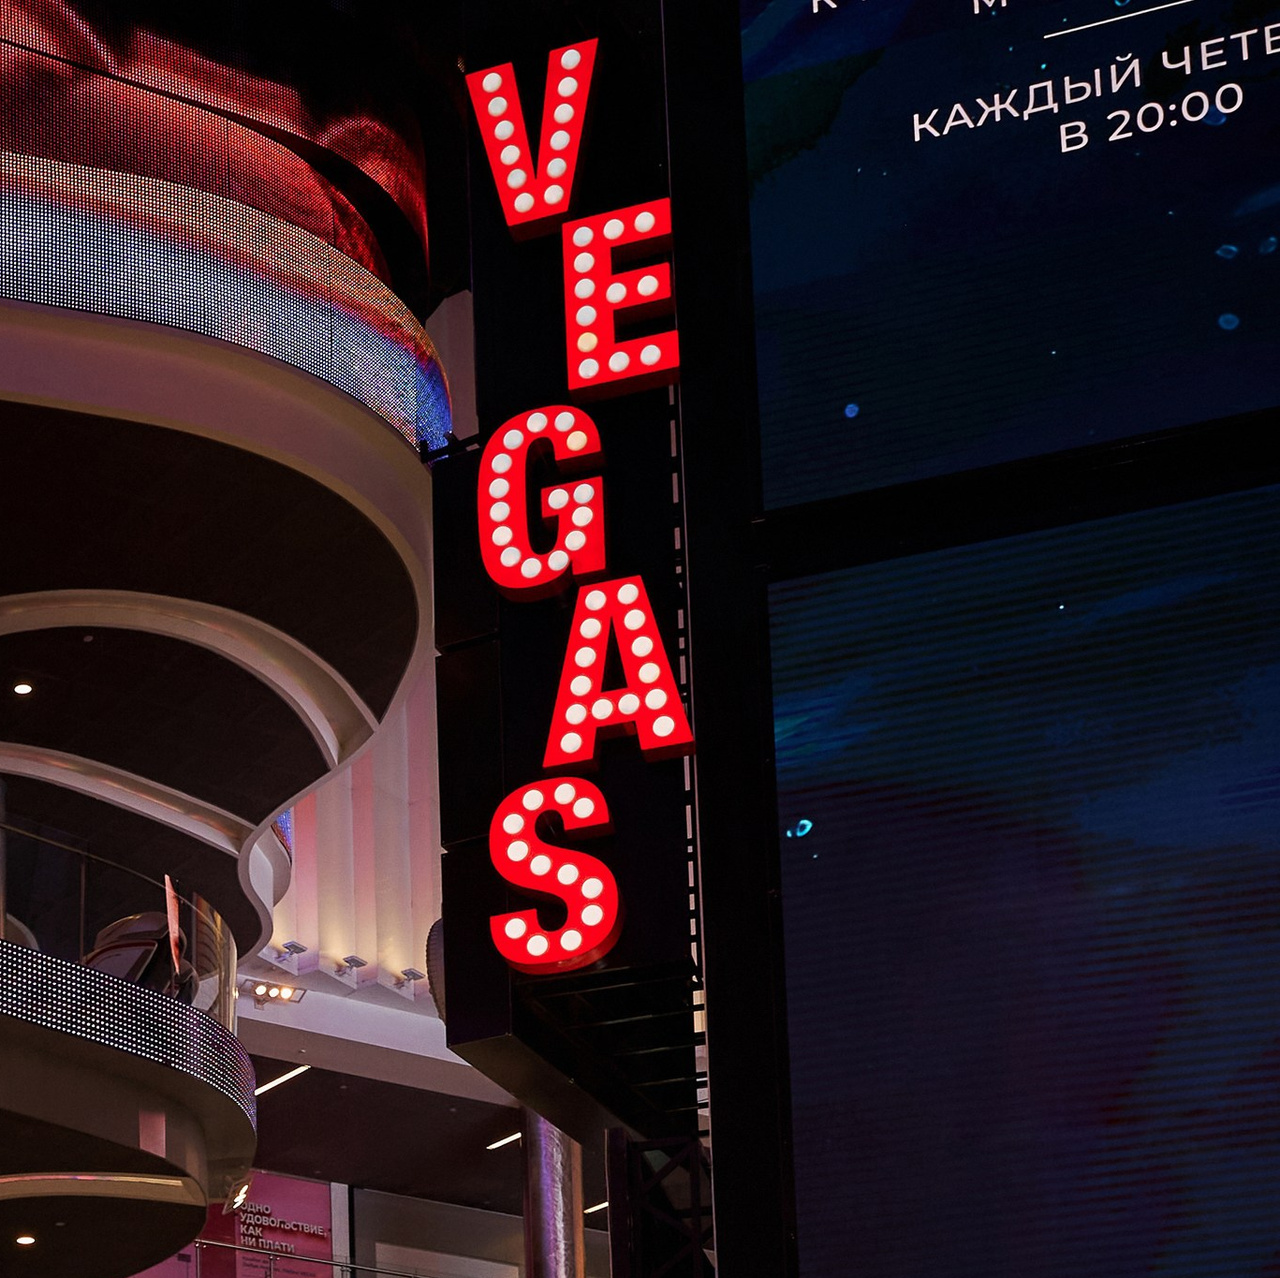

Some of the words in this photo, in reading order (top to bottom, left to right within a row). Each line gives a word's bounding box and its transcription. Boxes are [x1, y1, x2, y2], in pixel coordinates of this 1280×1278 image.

[912, 53, 1142, 142] КАЖДЫЙ
[1059, 121, 1089, 153] В
[1108, 83, 1244, 142] 20:00
[465, 37, 695, 976] VEGAS
[240, 1202, 271, 1214] ОДНО
[239, 1212, 328, 1238] УДОВОЛЬСТВИЕ,
[240, 1224, 263, 1237] КАК
[240, 1235, 257, 1247] НИ
[258, 1240, 296, 1253] ПЛАТИ
